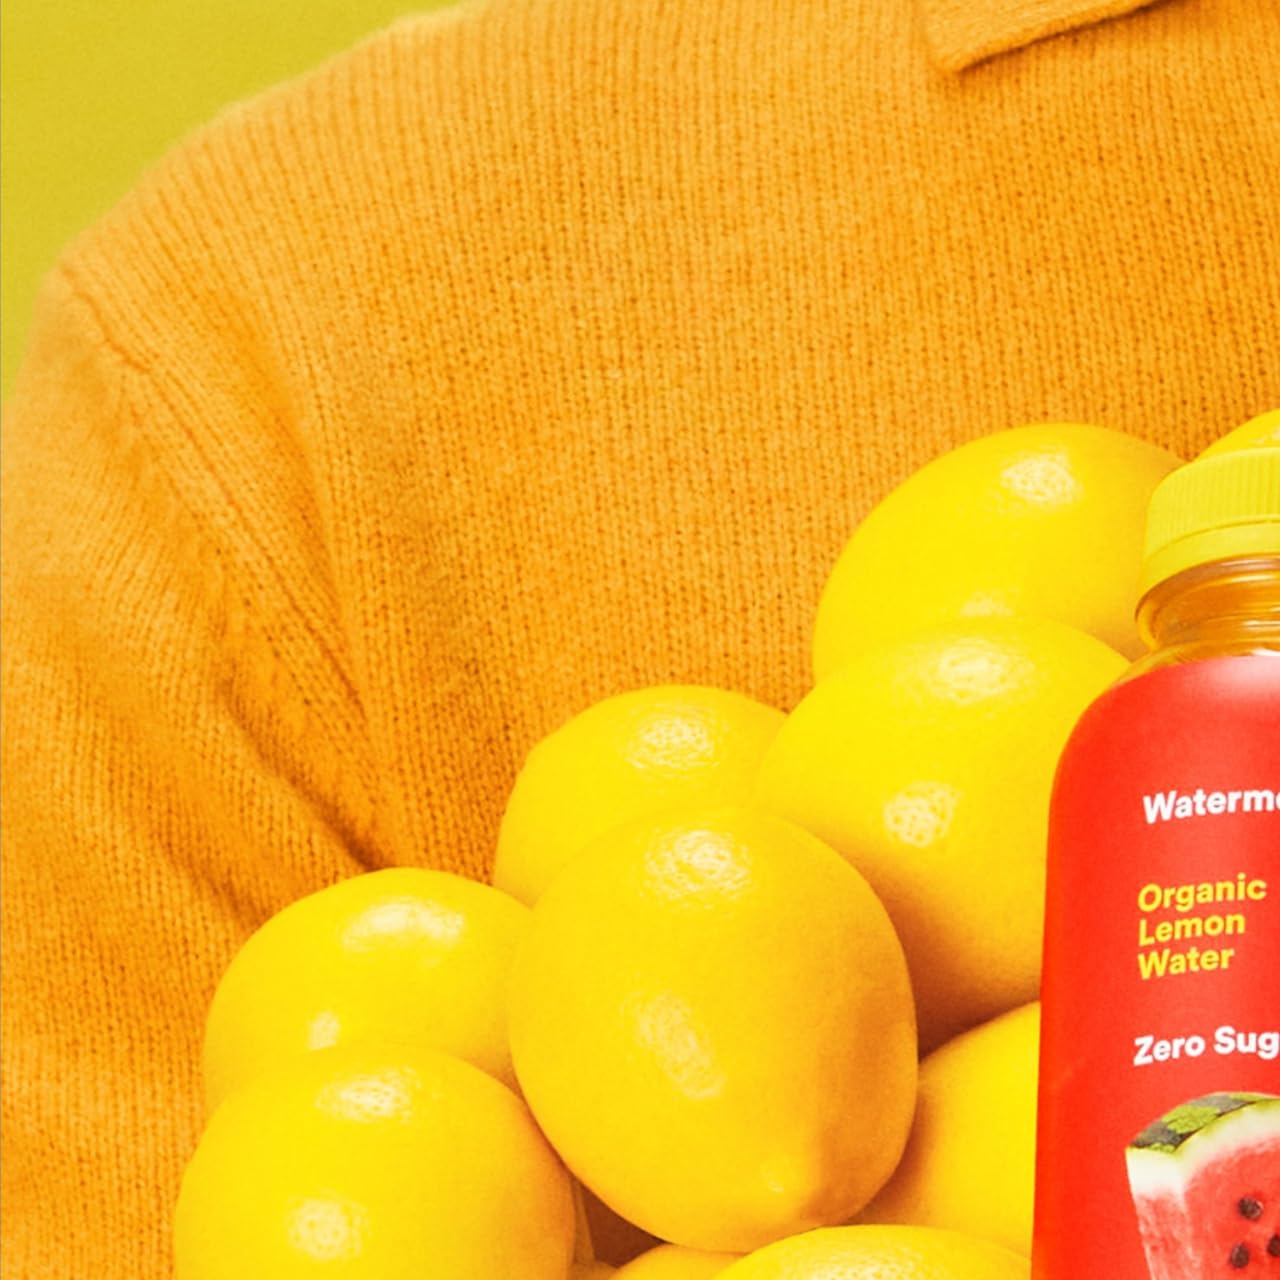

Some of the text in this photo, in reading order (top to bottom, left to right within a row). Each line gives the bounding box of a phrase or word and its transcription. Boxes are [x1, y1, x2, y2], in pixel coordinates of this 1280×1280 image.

[1137, 873, 1267, 913] Organic
[1138, 913, 1246, 946] Lemon
[1137, 947, 1235, 980] Water
[1133, 1034, 1206, 1066] Zero
